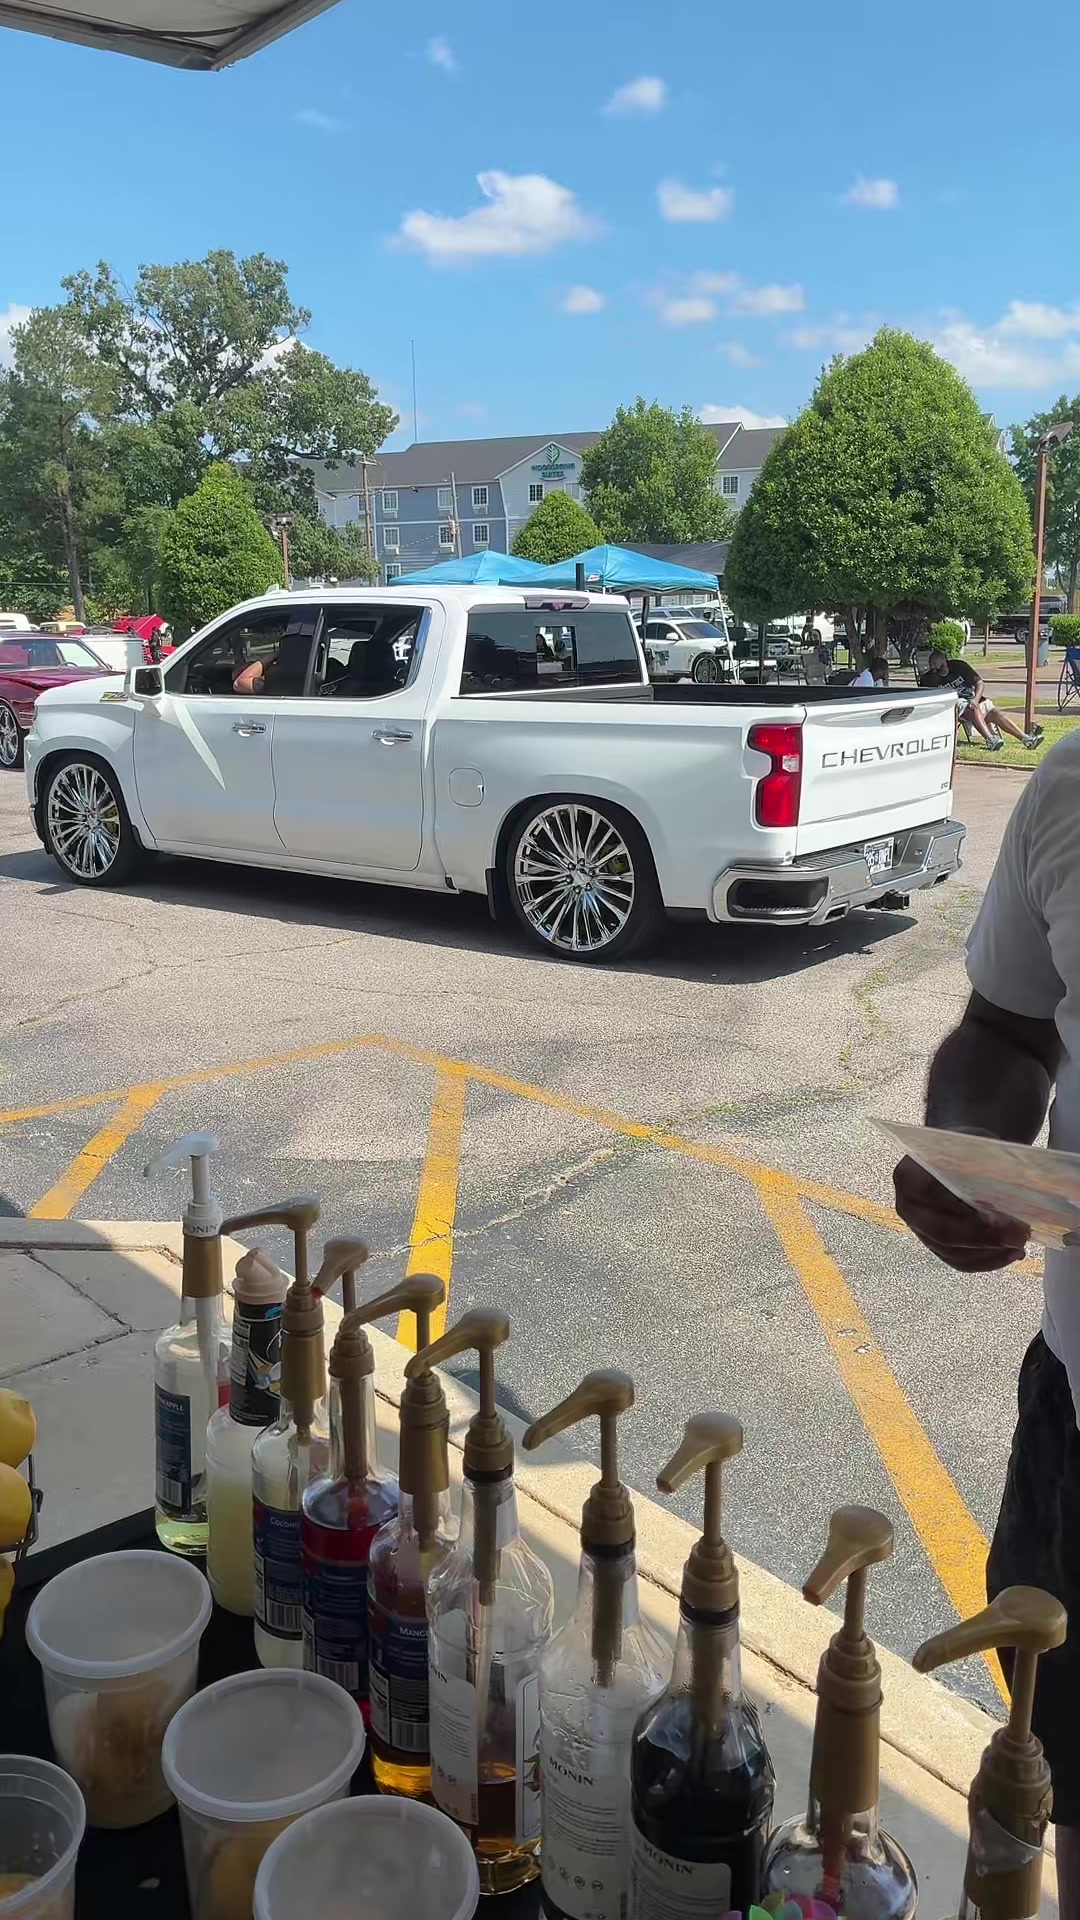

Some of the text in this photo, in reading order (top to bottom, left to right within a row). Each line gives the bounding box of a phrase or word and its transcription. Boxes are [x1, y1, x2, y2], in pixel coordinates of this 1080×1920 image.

[821, 733, 952, 769] CHEVROLET
[270, 1516, 301, 1529] COCONU
[549, 1755, 594, 1787] MONIN
[643, 1842, 693, 1875] MONIN
